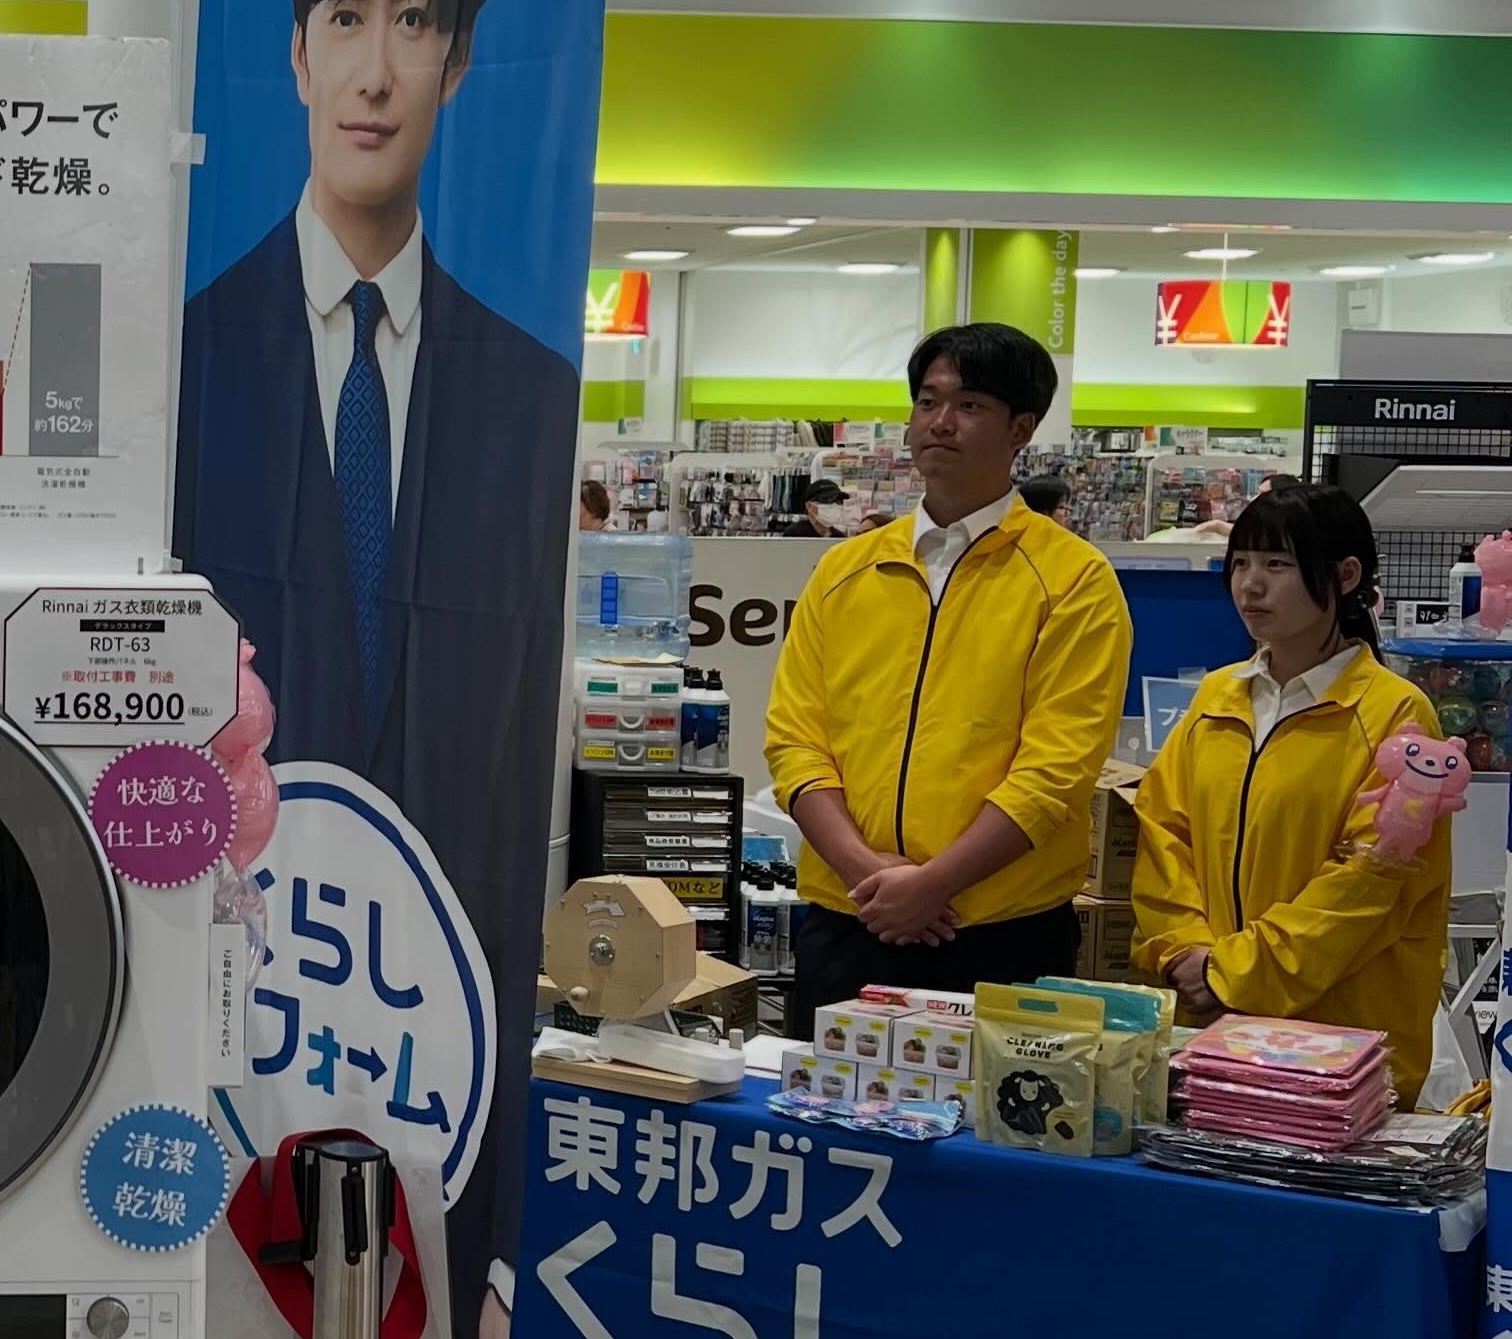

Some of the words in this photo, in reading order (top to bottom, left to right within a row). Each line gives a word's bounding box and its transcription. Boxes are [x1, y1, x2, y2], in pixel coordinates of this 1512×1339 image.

[1051, 229, 1072, 265] day
[1050, 269, 1066, 300] the
[1048, 303, 1065, 349] Color
[45, 391, 84, 411] 5kgで
[1374, 397, 1456, 421] Rinnai
[34, 415, 94, 434] 約162分
[42, 599, 88, 614] Rinnai
[93, 599, 203, 616] ガス衣類乾燥機
[90, 636, 151, 653] RDT-63
[149, 670, 175, 684] 別途
[35, 691, 185, 726] ¥168,900
[117, 775, 206, 807] 快適な
[103, 817, 218, 849] 仕上がり
[1016, 1047, 1051, 1059] GLOVE
[122, 1131, 197, 1175] 清潔
[544, 1096, 903, 1248] 東邦ガス
[112, 1181, 186, 1227] 乾燥
